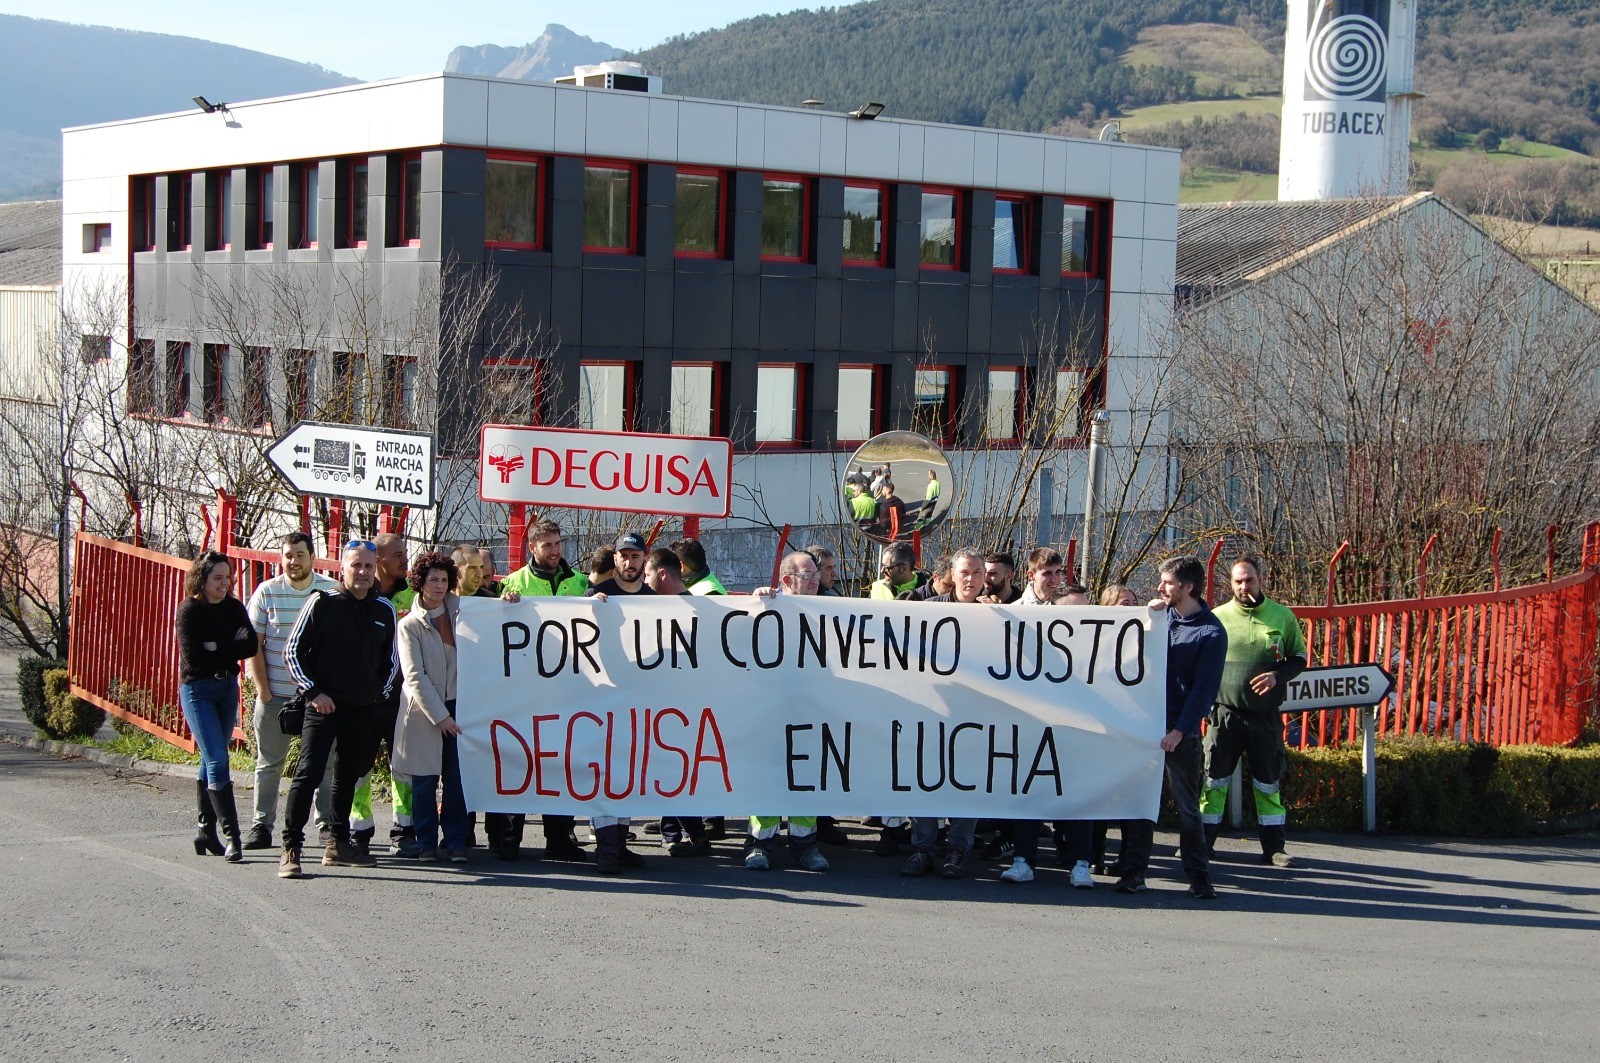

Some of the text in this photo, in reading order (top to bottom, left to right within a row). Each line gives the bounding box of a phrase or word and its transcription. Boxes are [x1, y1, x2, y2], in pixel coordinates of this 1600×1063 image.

[1302, 111, 1385, 136] TUBACEX
[376, 440, 424, 456] ENTRADA
[375, 455, 424, 472] MARCHA
[531, 446, 720, 498] DEGUISA
[375, 472, 423, 496] ATRÁS
[501, 609, 1145, 687] POR UN CONVENIO JUSTO
[1283, 675, 1370, 701] TAINERS
[490, 708, 1063, 801] DEGUISA EN LUCHA
